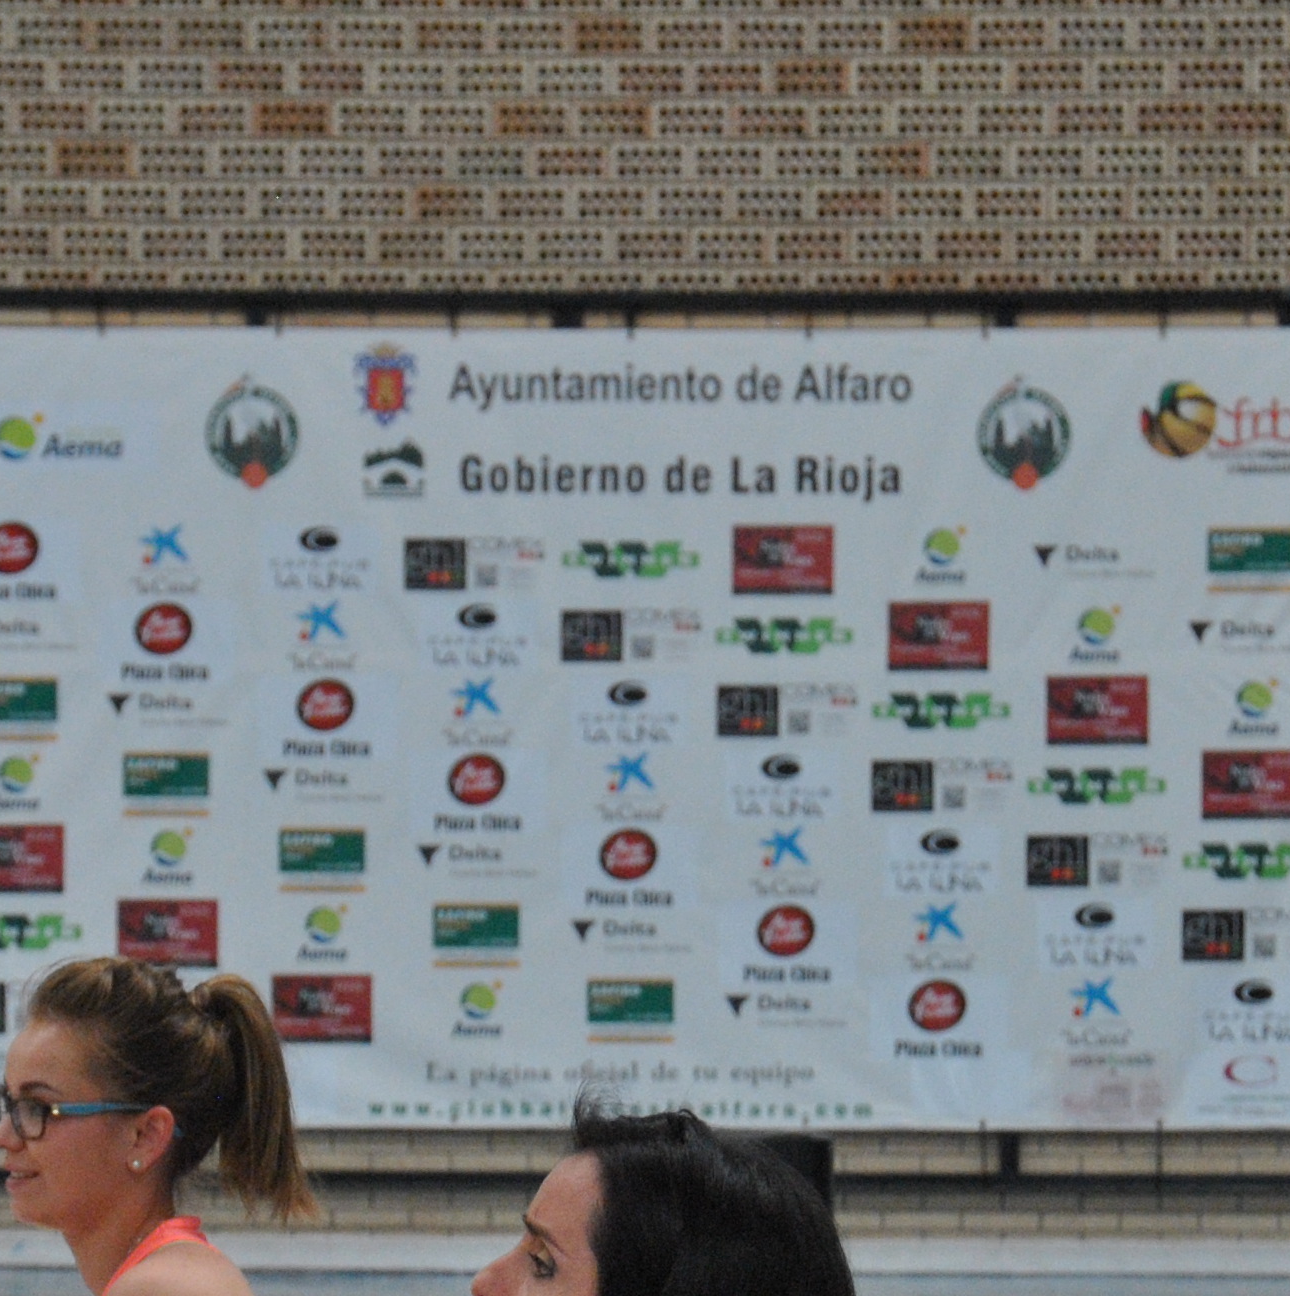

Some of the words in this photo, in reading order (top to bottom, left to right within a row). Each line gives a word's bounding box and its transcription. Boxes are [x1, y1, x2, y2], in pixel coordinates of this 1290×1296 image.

[449, 361, 724, 411] Ayuntamiento
[736, 362, 784, 402] de
[794, 361, 913, 402] Alfaro
[459, 454, 647, 495] Gobierno
[664, 455, 713, 495] de
[730, 455, 776, 495] La
[795, 454, 901, 502] Rioja
